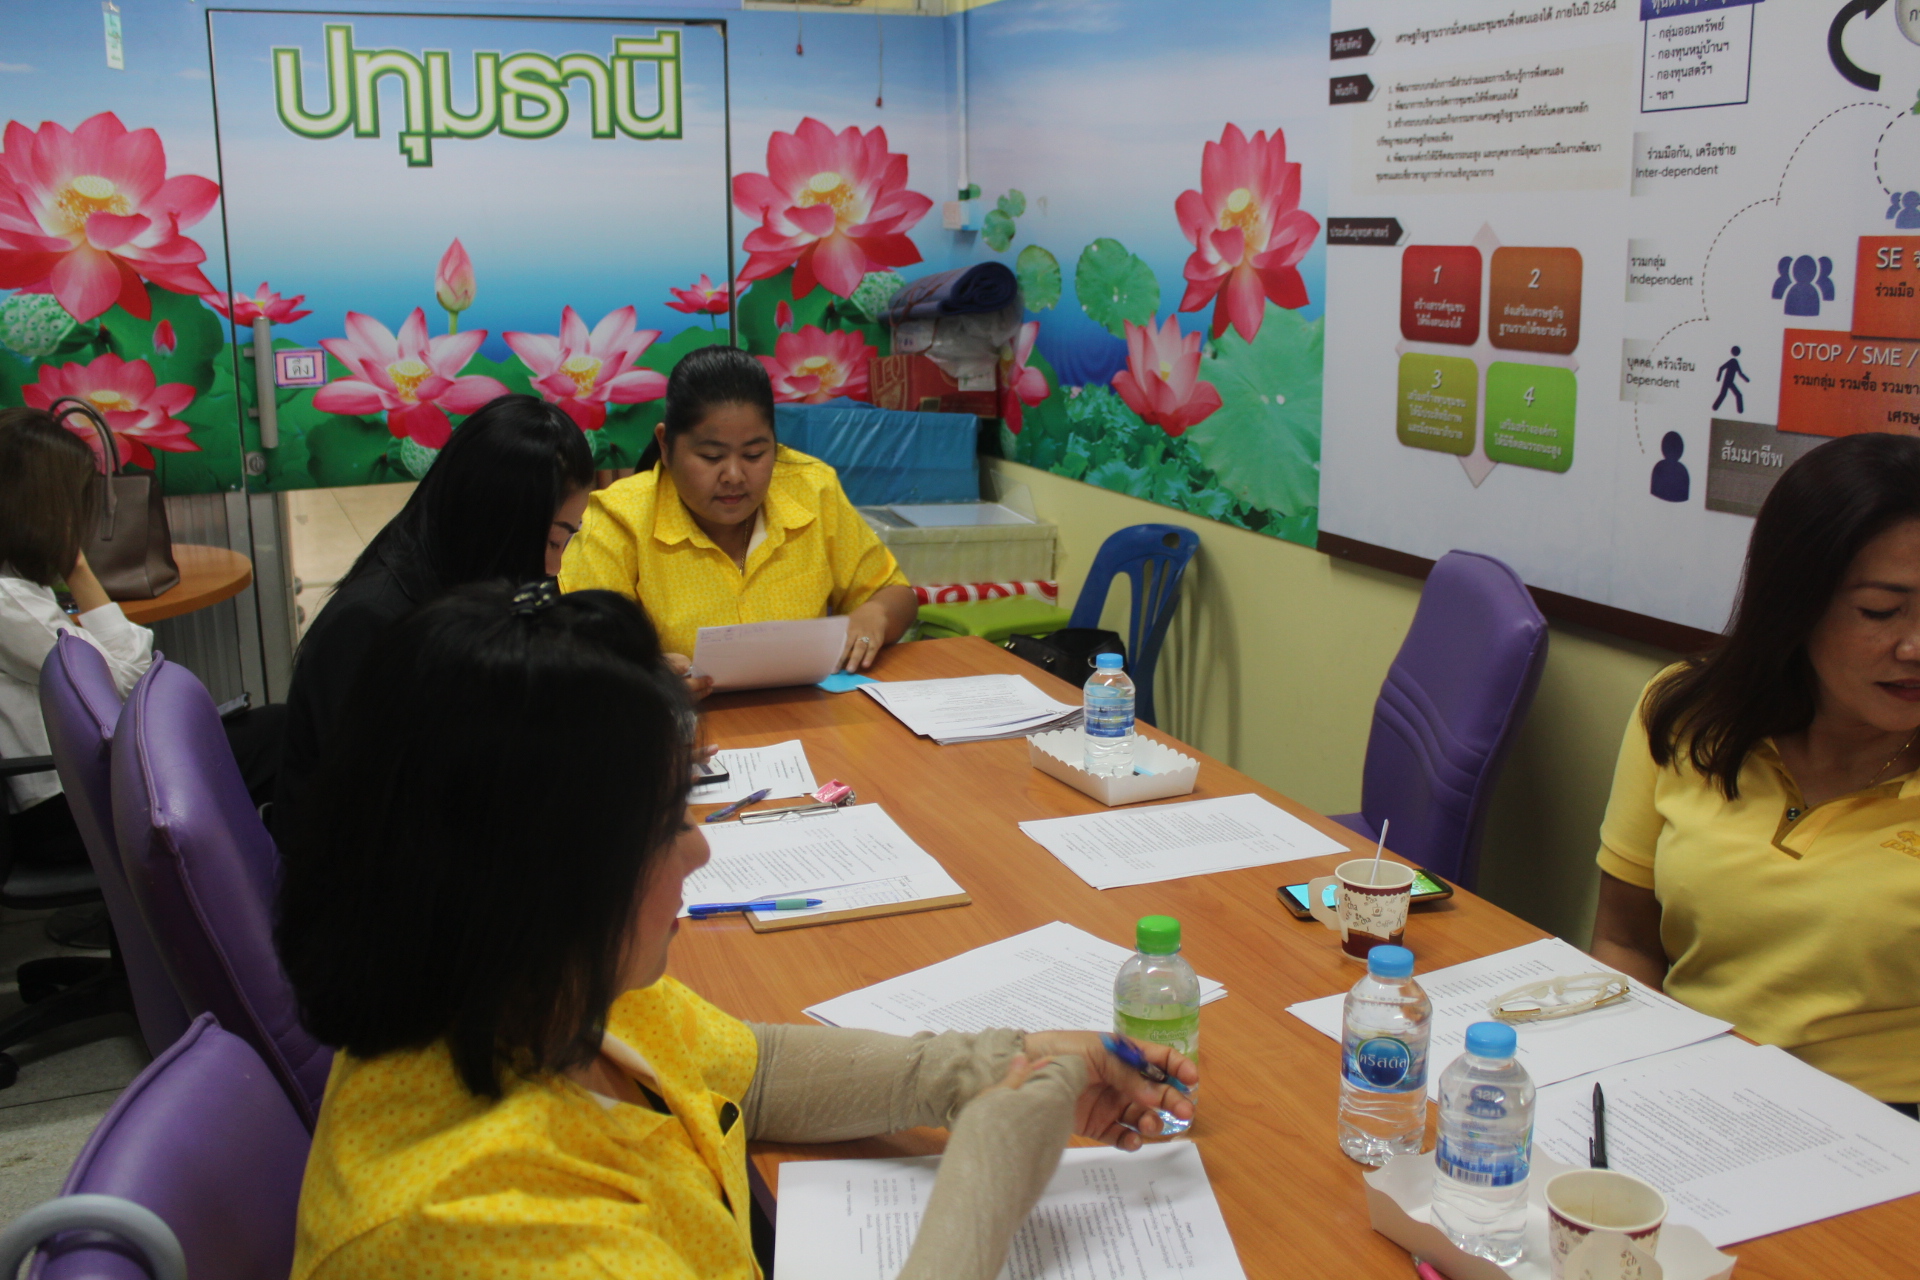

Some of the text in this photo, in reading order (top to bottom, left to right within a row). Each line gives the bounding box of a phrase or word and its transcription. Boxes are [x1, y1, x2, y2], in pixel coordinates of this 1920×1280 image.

[1593, 0, 1617, 14] 2564
[1658, 16, 1725, 42] กลุ่มออมทรัพย์
[1657, 39, 1730, 60] กองทุนหมู่บ้านฯ
[1656, 61, 1713, 82] กองทุนสตรีฯ
[271, 23, 683, 168] ปทุมธานี
[1656, 90, 1675, 100] ฯลฯ
[1695, 142, 1737, 158] เครือข่าย
[1635, 165, 1718, 179] Inter-dependent
[1631, 254, 1666, 269] รวมกลุ่ม
[1876, 247, 1903, 269] SE
[1432, 265, 1442, 284] 1
[1528, 268, 1541, 289] 2
[1629, 273, 1693, 287] Independent
[1657, 355, 1695, 372] ครัวเรือน
[1791, 342, 1919, 368] OTOP / SME /
[1431, 369, 1442, 389] 3
[1625, 374, 1680, 388] Dependent
[1793, 374, 1835, 391] รวมกลุ่ม
[1882, 381, 1920, 395] รวมขา
[1523, 386, 1535, 407] 4
[1721, 440, 1784, 468] สัมมาชีพ
[1359, 1053, 1408, 1069] คริสตัล
